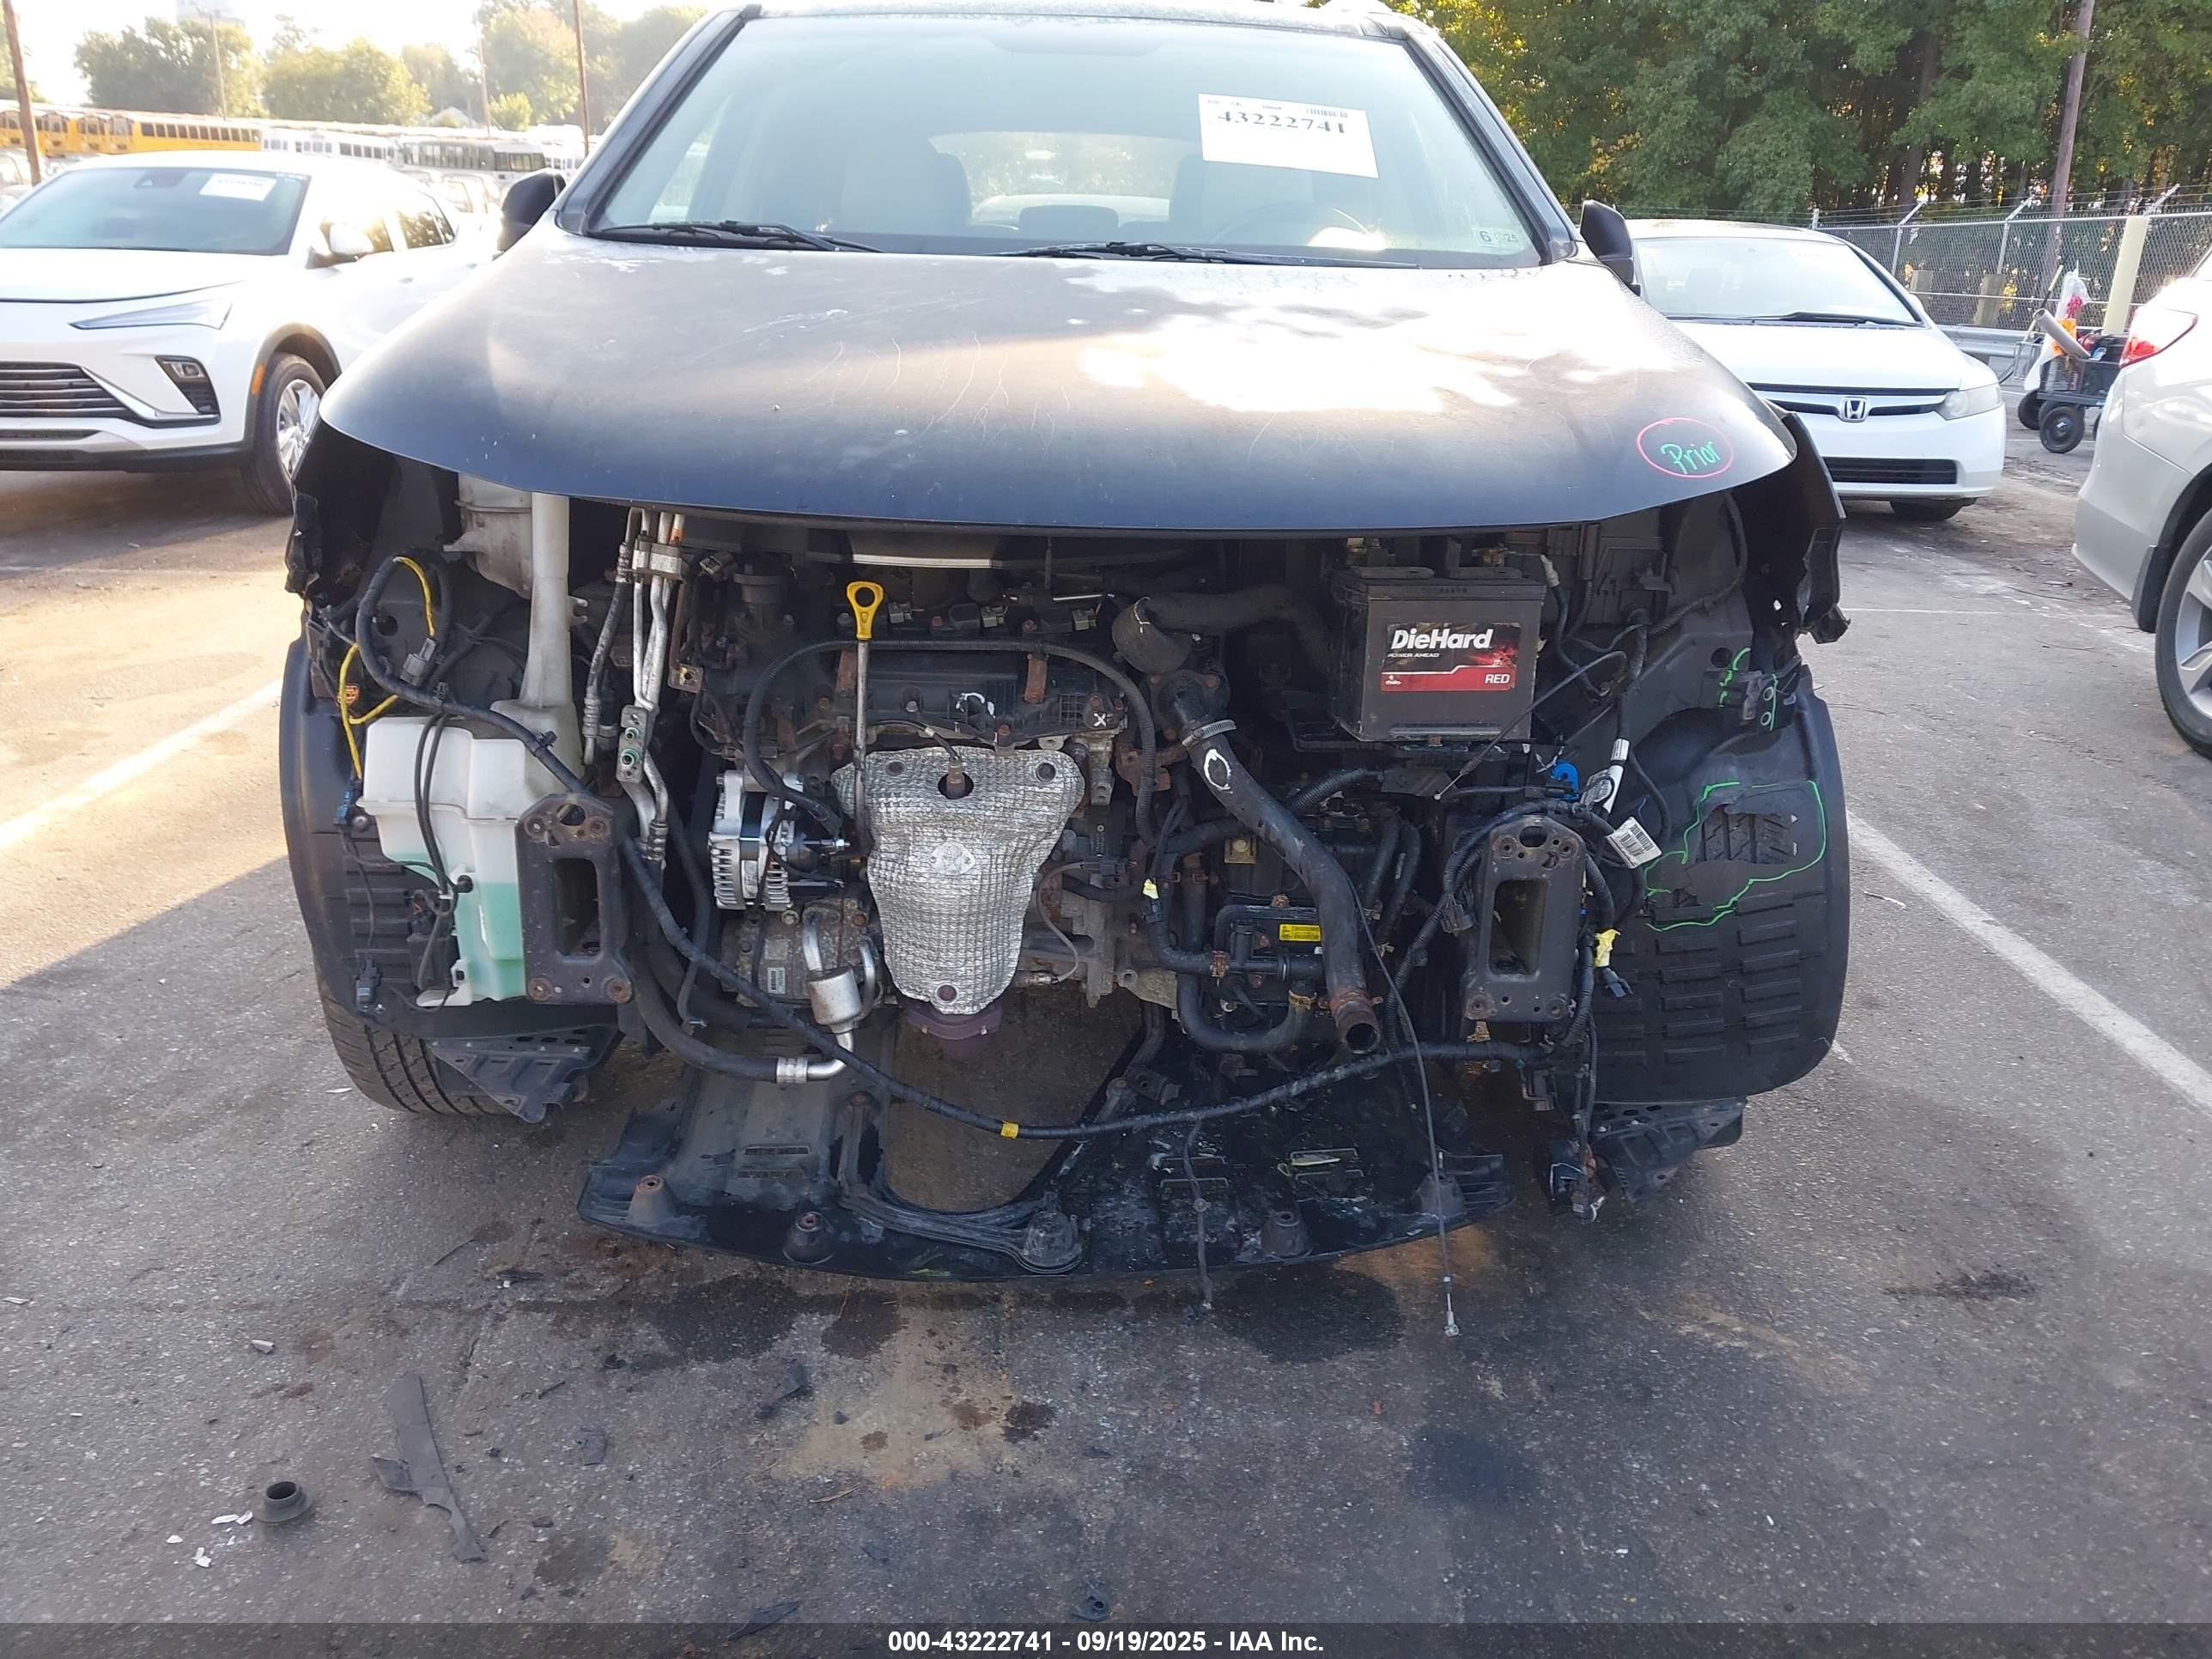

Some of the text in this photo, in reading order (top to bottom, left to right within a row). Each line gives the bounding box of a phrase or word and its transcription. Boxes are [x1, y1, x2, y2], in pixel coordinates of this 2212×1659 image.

[1218, 112, 1345, 134] 43222741
[1479, 230, 1492, 242] 6
[1660, 441, 1721, 475] Prior
[1390, 628, 1494, 649] DieHard
[1485, 674, 1510, 684] RED
